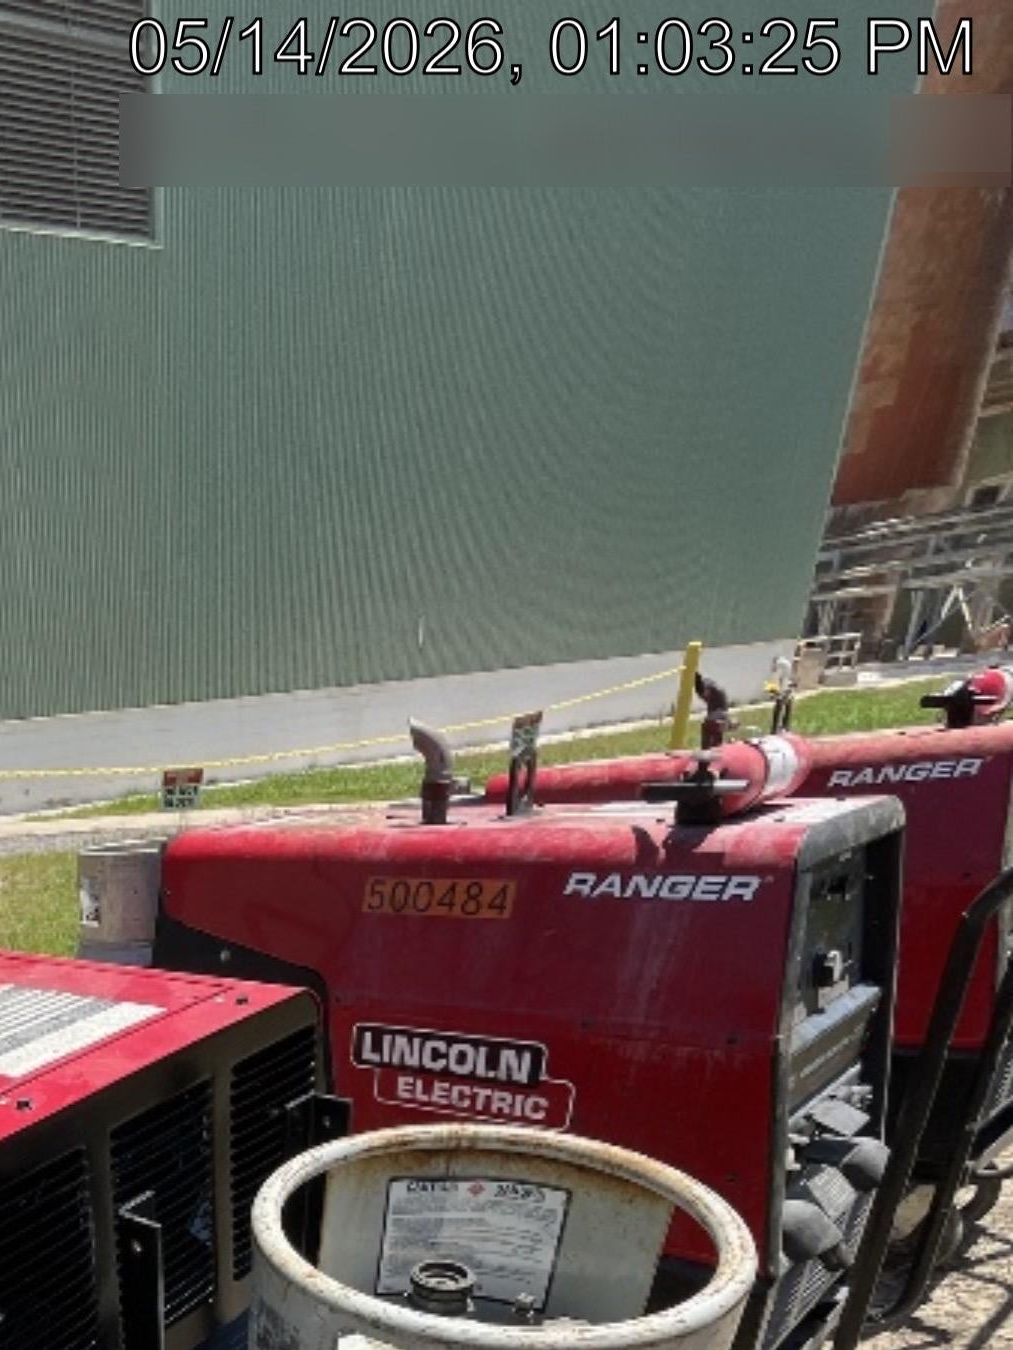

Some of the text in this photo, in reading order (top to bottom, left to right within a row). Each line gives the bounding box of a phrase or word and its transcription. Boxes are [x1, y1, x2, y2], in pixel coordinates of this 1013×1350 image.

[827, 758, 983, 788] RANGER
[368, 878, 510, 916] 500484
[563, 872, 761, 901] RANGER
[361, 1031, 531, 1084] LINCOLN
[397, 1077, 549, 1120] ELECTRIC
